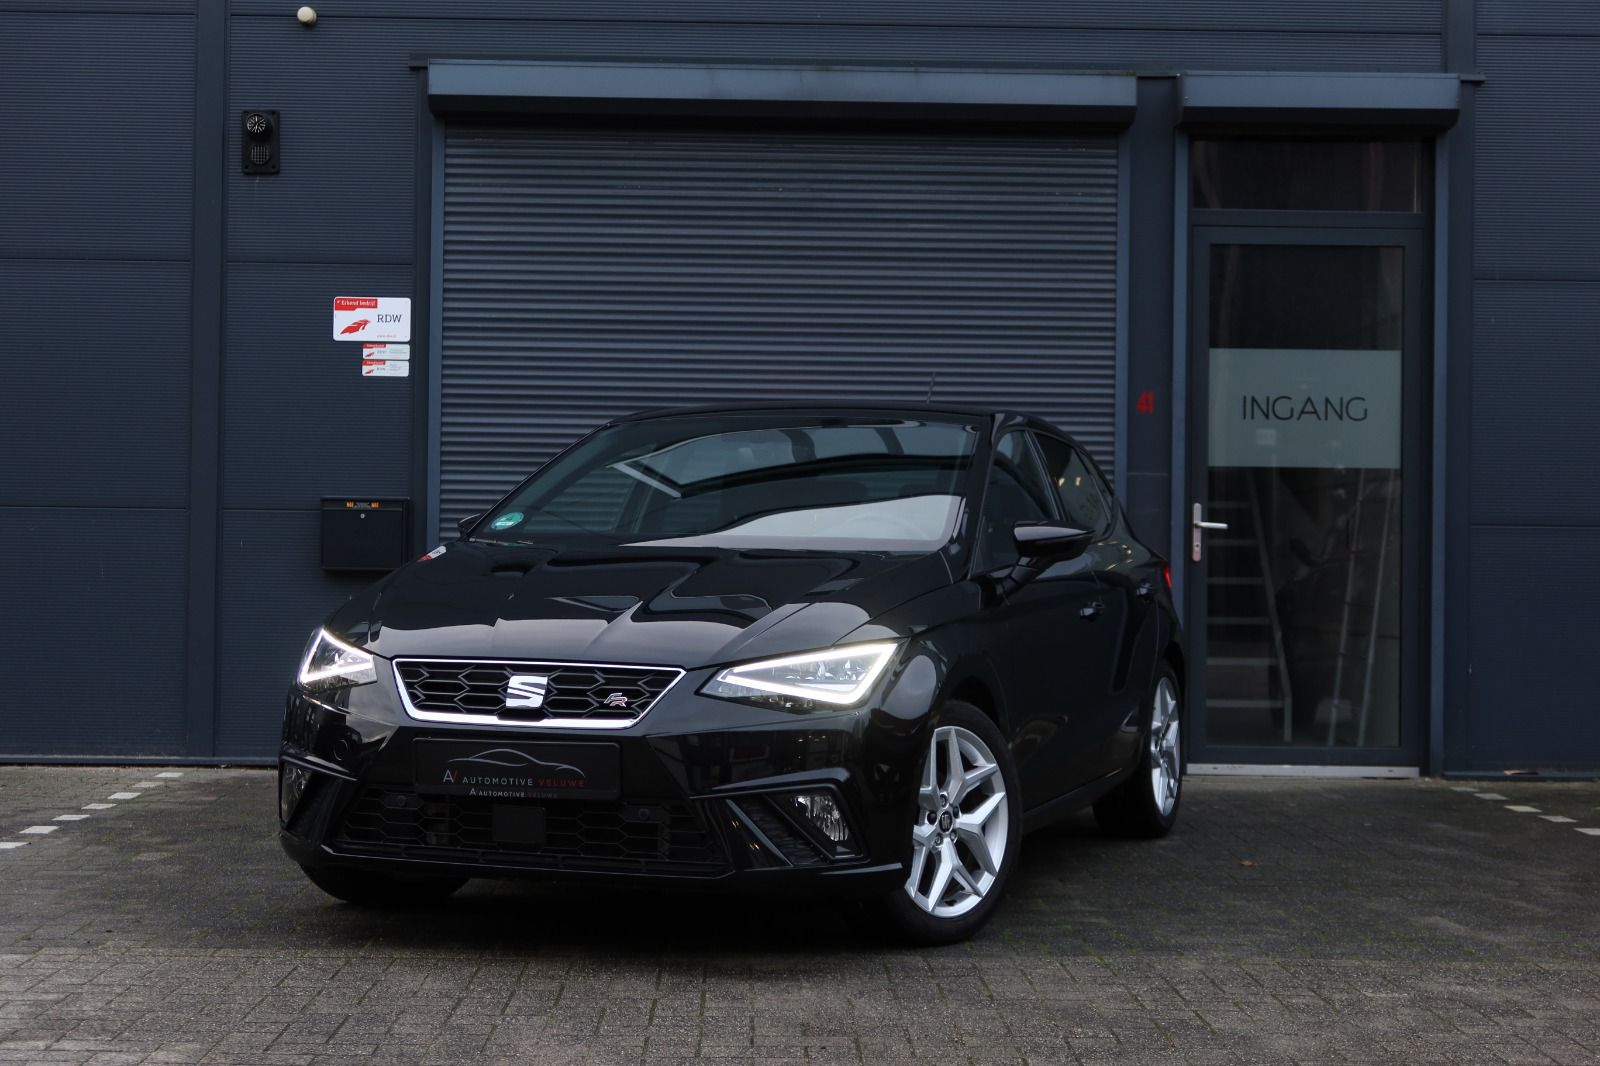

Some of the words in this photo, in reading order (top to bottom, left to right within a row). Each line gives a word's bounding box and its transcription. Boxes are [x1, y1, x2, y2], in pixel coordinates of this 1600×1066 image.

[376, 313, 402, 323] RDW
[1242, 395, 1368, 422] INGANG
[462, 776, 534, 786] AUTOMOTIVE
[537, 777, 586, 788] VELUWE
[478, 790, 526, 798] AUTOMOTIVE
